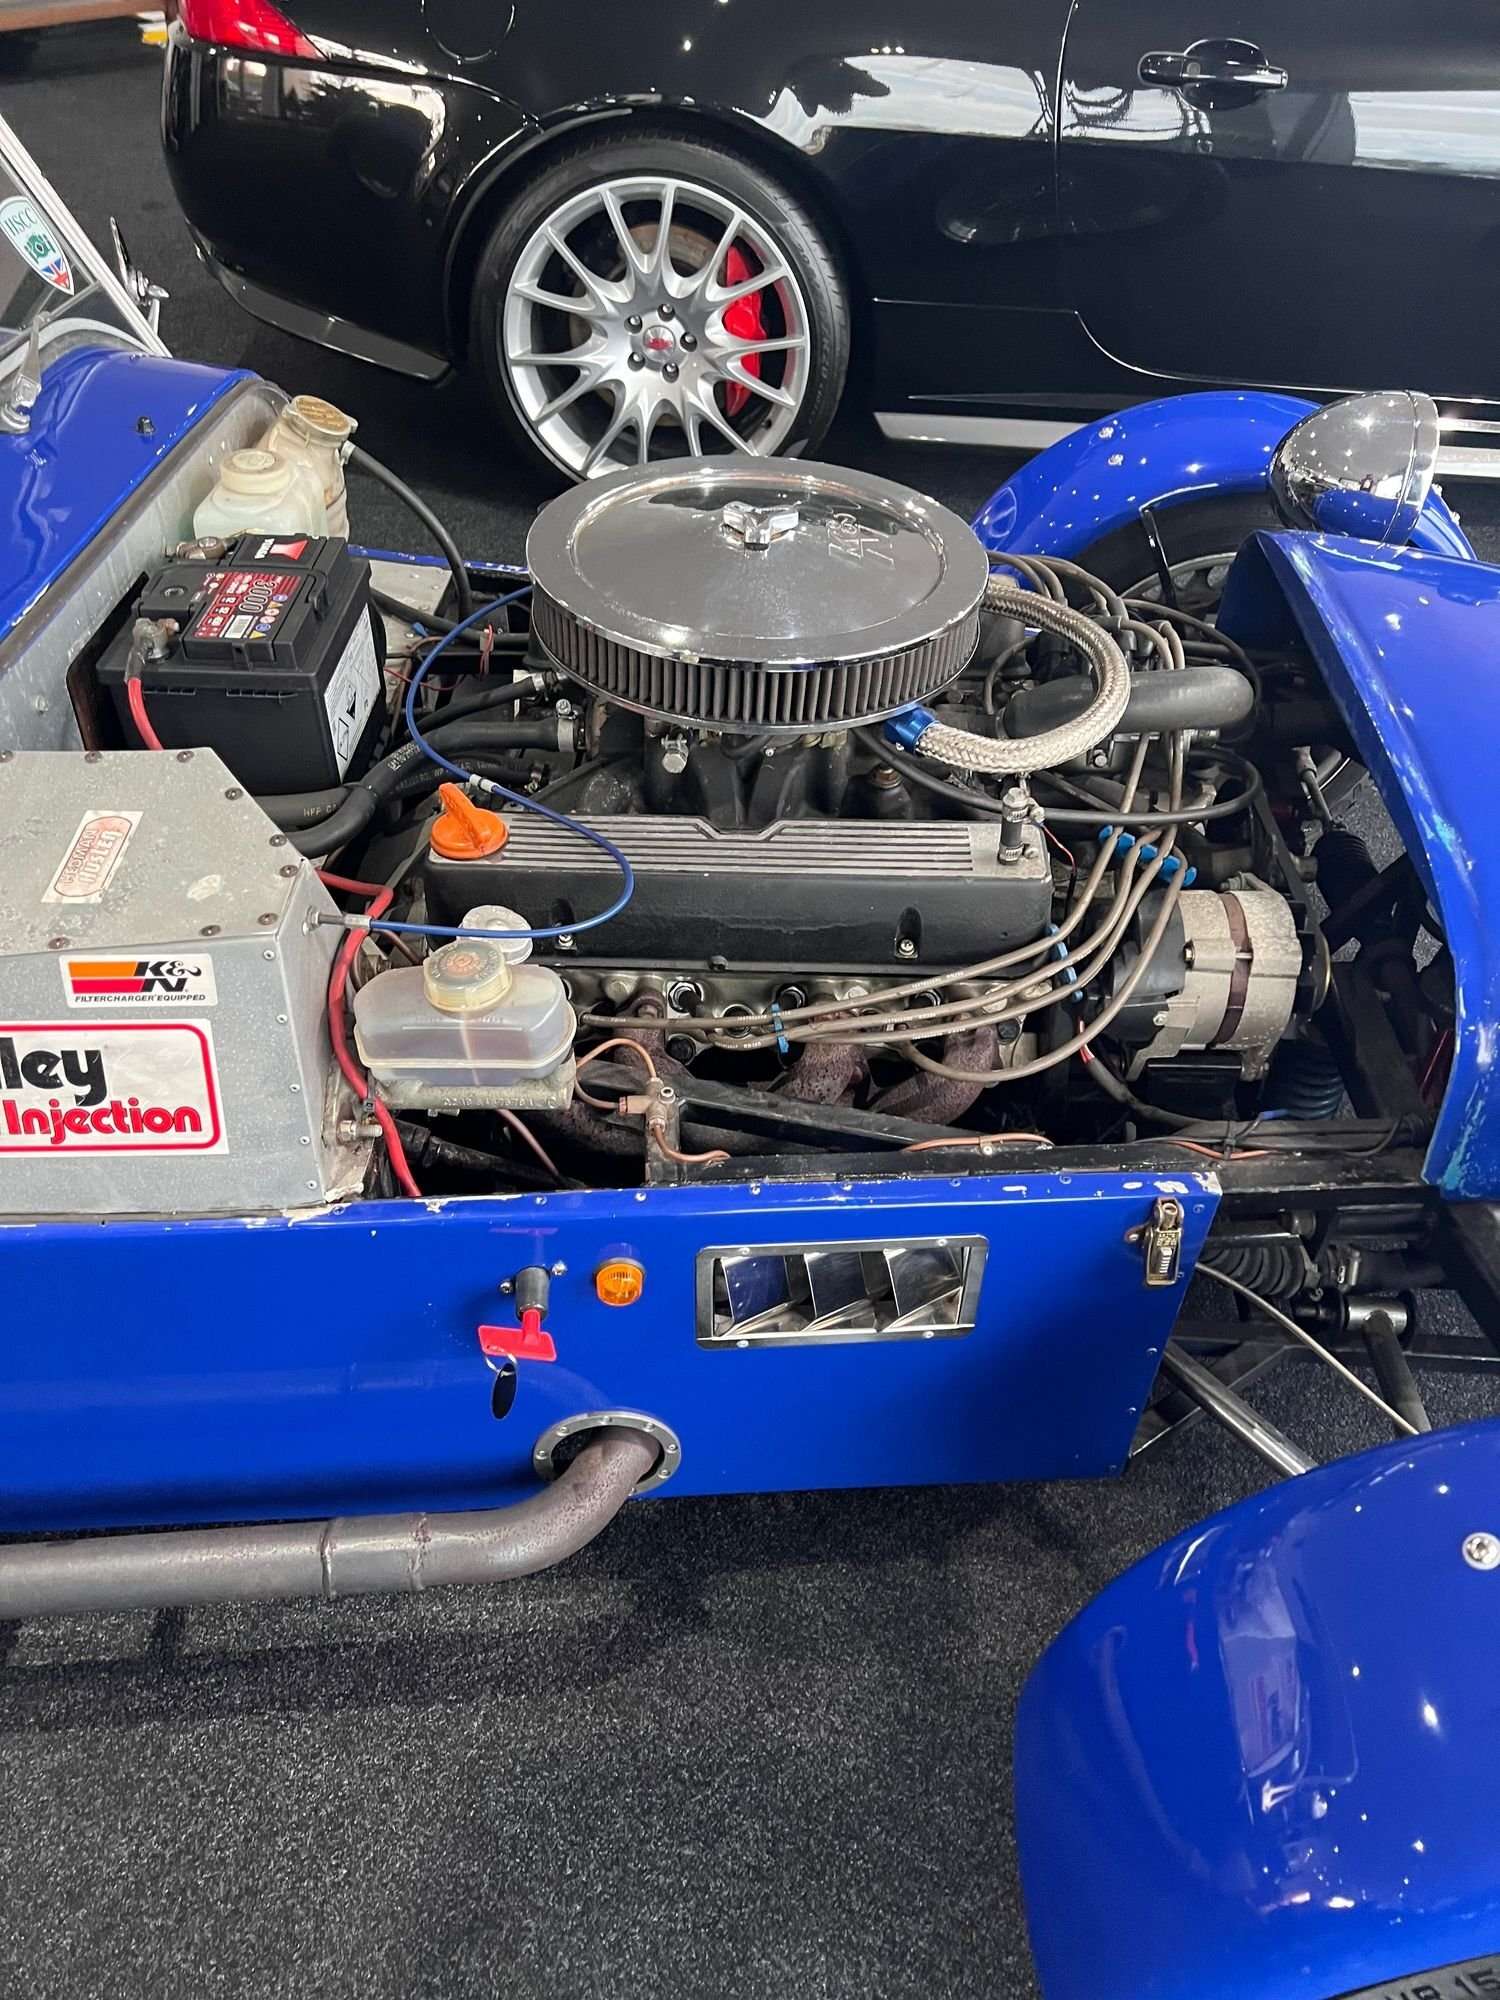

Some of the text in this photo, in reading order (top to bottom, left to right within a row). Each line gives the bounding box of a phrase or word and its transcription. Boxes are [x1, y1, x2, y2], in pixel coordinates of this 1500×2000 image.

[4, 207, 38, 236] HSCC
[239, 580, 277, 612] 3000
[157, 993, 206, 1001] EQUIPPED
[0, 1037, 107, 1106] ley
[2, 1098, 202, 1144] Injection
